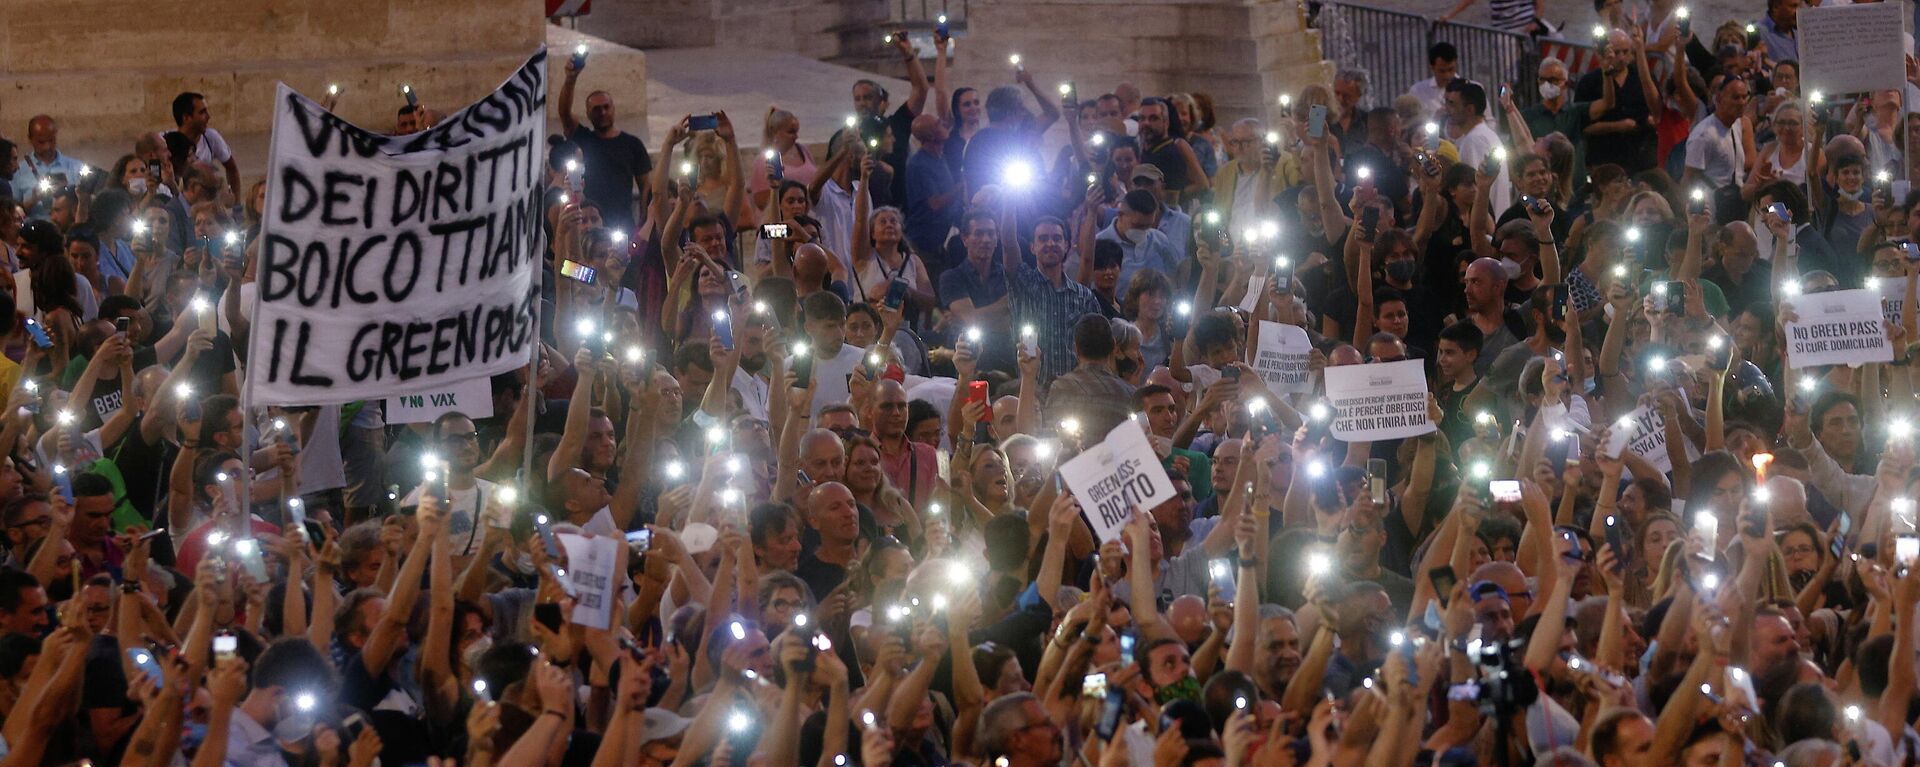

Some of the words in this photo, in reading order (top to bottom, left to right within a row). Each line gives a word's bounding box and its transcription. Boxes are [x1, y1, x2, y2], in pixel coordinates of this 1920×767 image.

[279, 165, 377, 229] DEI
[391, 129, 534, 226] DIRITTI
[1793, 326, 1808, 340] NO
[1811, 323, 1847, 338] GREEN
[268, 318, 333, 386] IL
[346, 304, 482, 382] GREEN
[1806, 341, 1828, 353] CURE
[1831, 337, 1884, 351] DOMICILIARI
[410, 395, 424, 408] NO
[430, 393, 457, 408] VAX
[1402, 391, 1424, 401] FINISCA
[1385, 401, 1425, 414] OBBEDISCI
[1335, 419, 1354, 432] CHE
[1356, 416, 1375, 431] NON
[1377, 413, 1407, 429] FINIRÀ
[1408, 413, 1426, 426] MAI
[1087, 475, 1121, 503] GREEN
